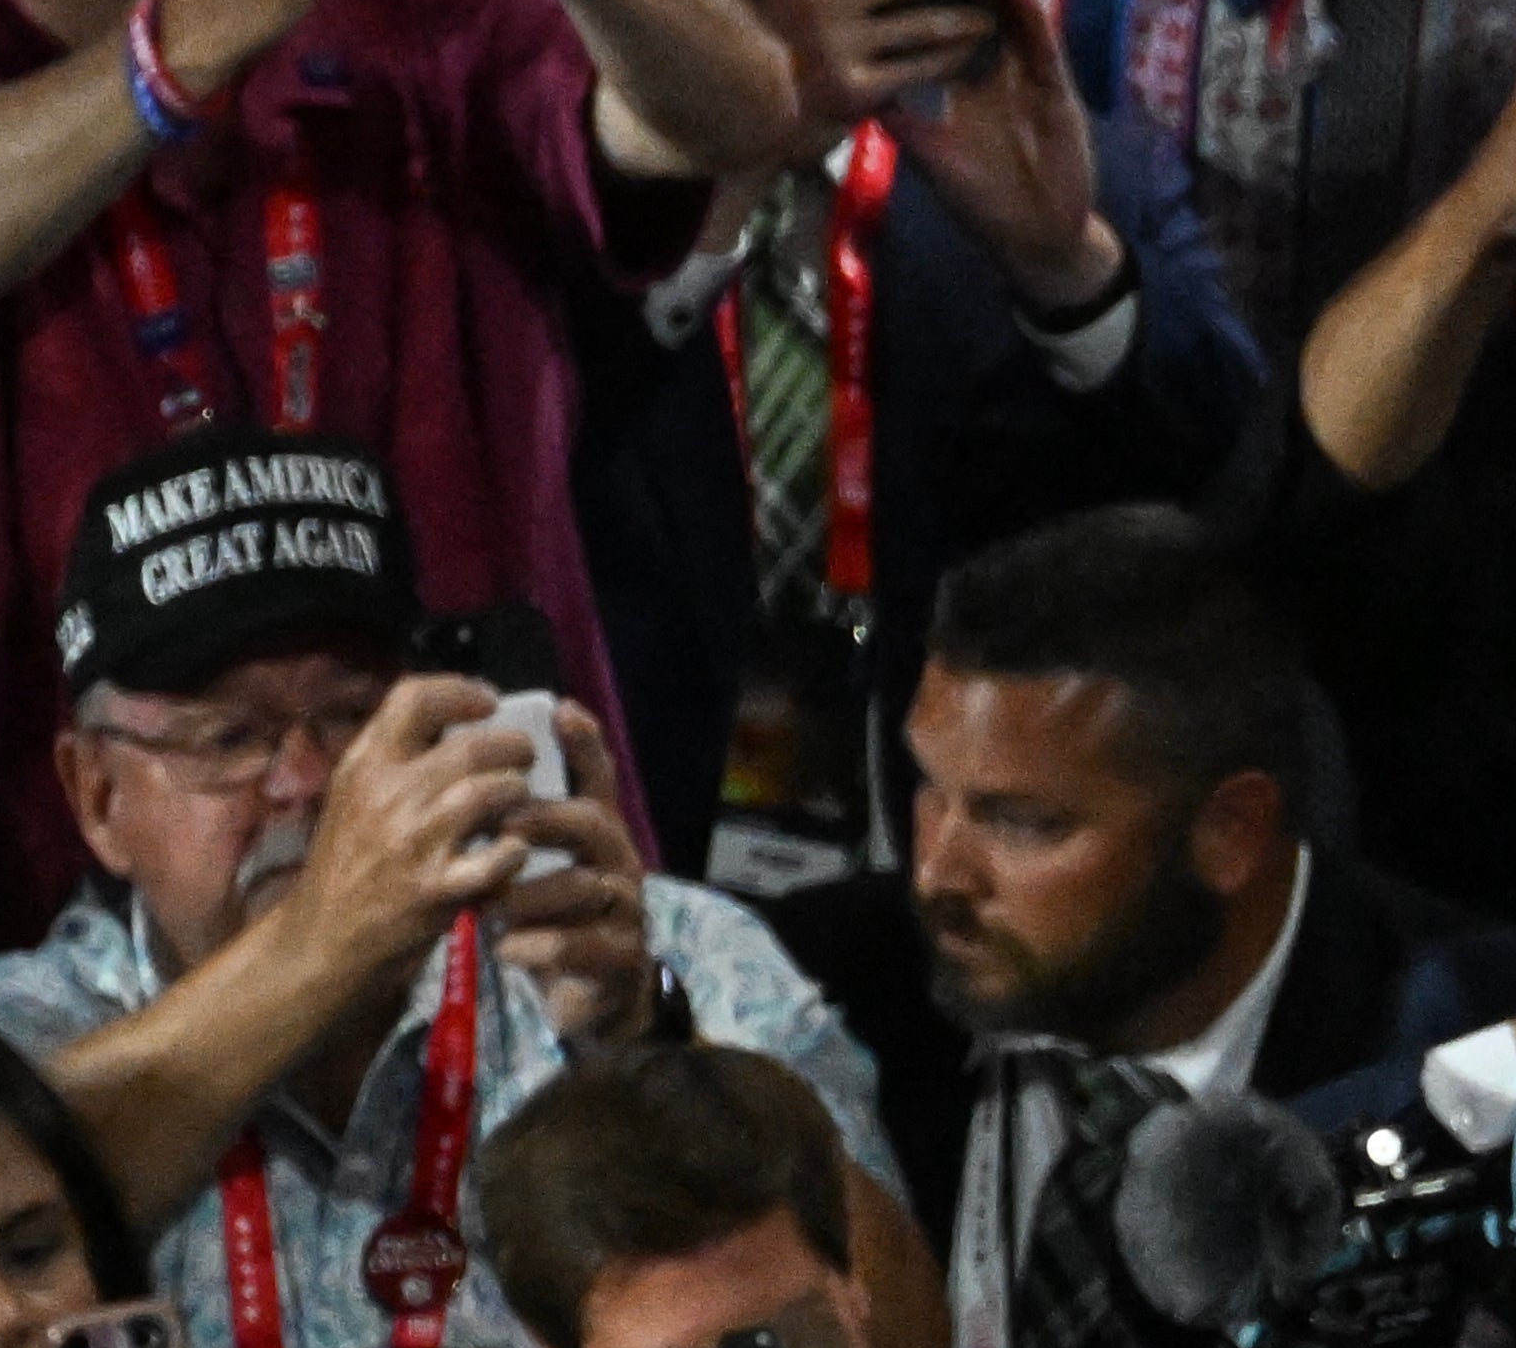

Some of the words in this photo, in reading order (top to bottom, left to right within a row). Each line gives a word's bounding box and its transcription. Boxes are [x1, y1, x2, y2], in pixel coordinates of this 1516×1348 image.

[103, 466, 222, 553] MAKE
[224, 453, 390, 520] AMERICA
[140, 521, 267, 605] GREAT
[273, 517, 381, 576] AGAIN
